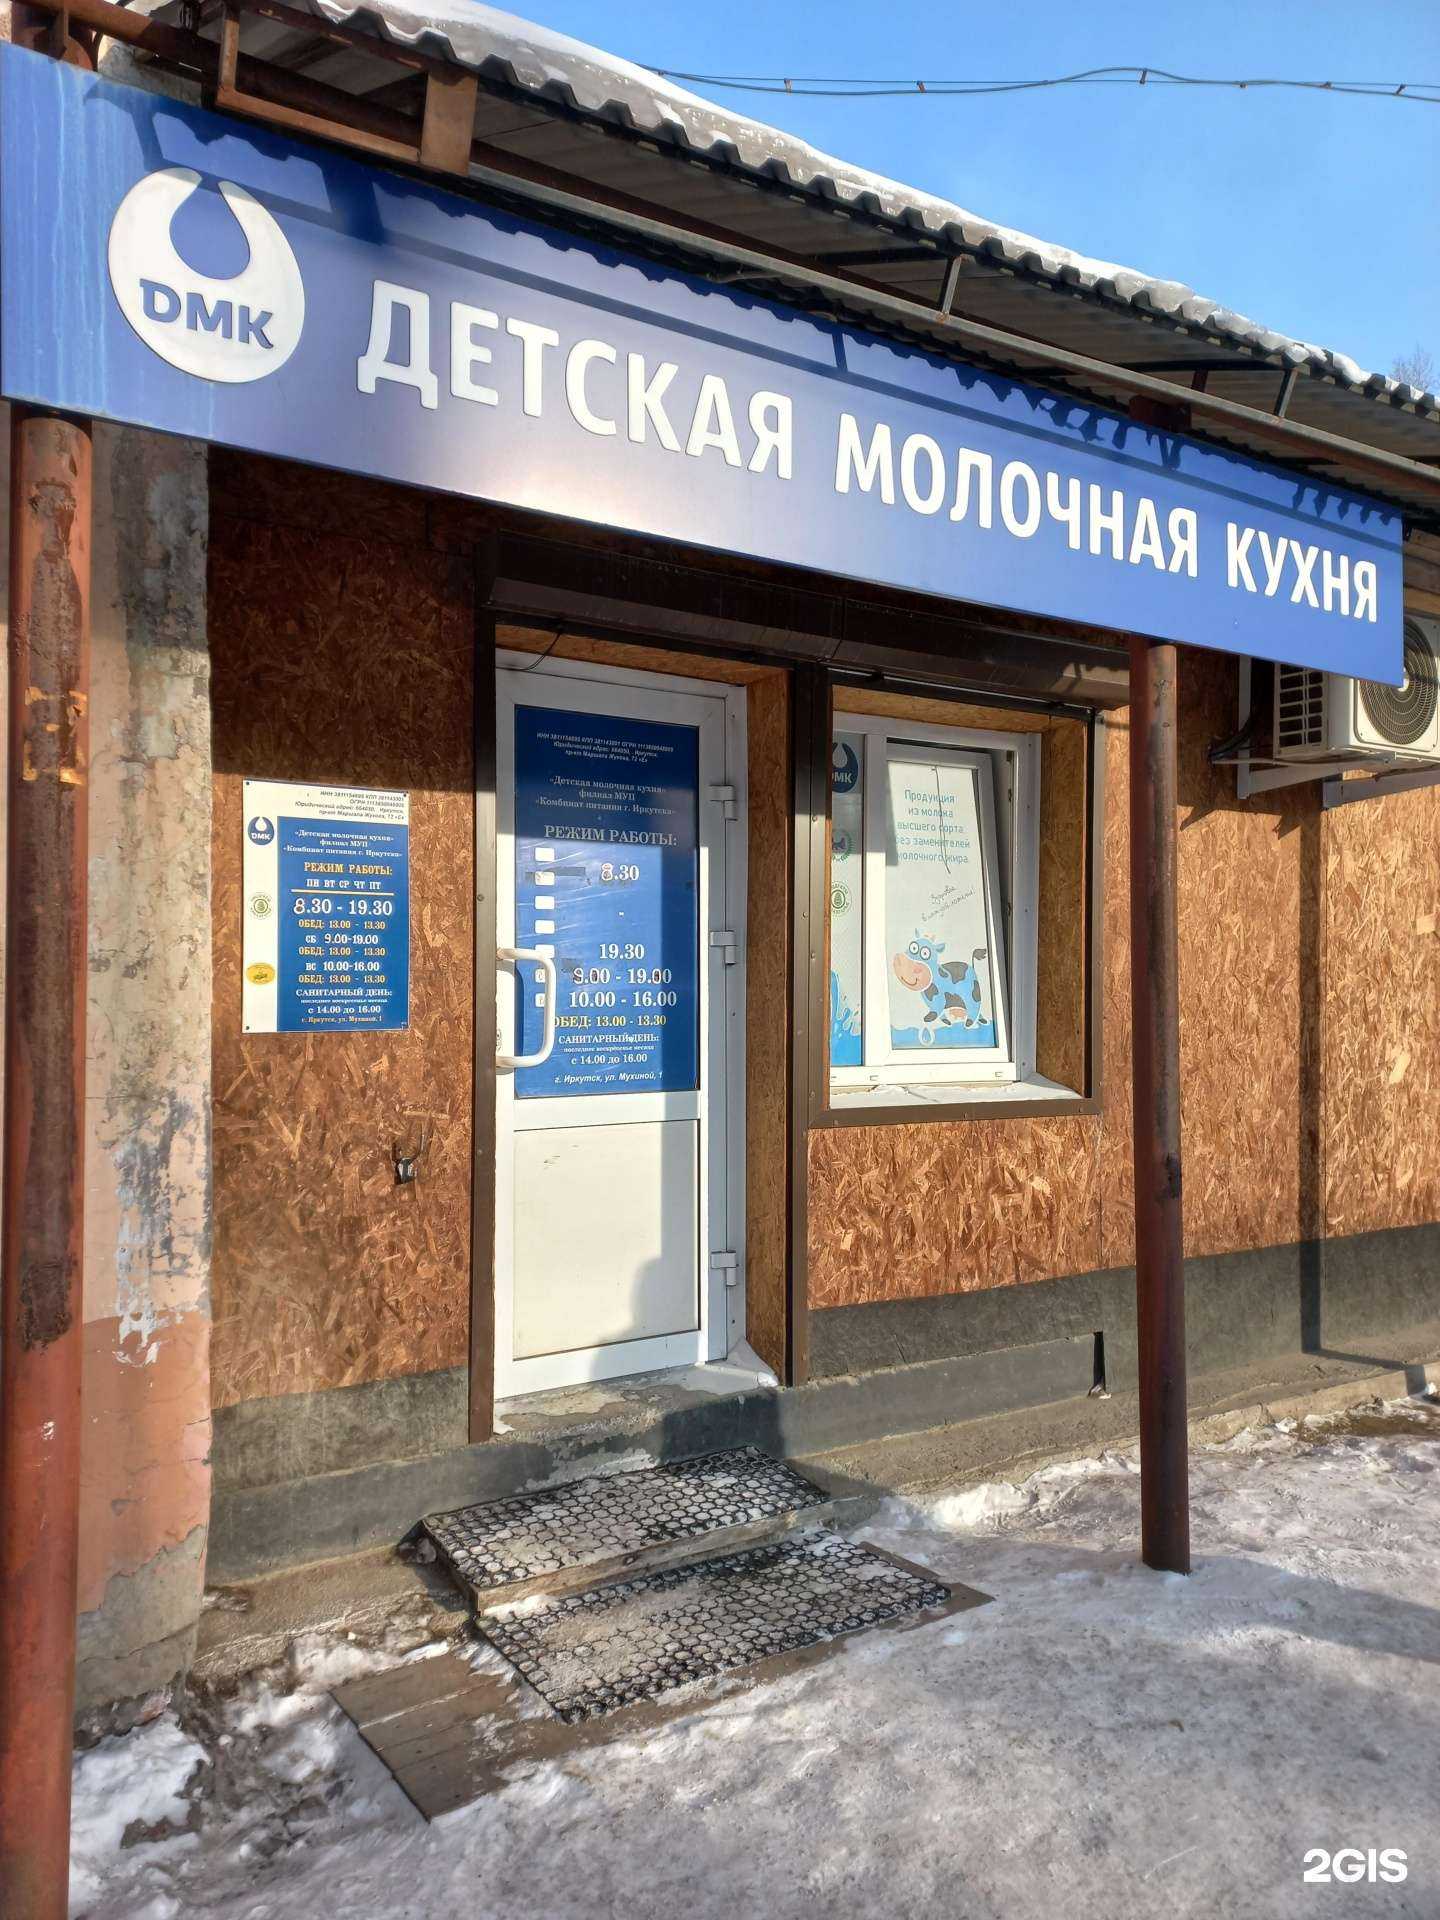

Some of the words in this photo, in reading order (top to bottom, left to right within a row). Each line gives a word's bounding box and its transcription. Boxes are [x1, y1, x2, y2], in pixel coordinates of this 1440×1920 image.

[357, 280, 793, 480] ДЕТСКАЯ
[834, 412, 1199, 578] МОЛОЧНАЯ
[1226, 521, 1378, 624] КУХНЯ
[832, 771, 853, 784] MK
[593, 781, 635, 791] молочная
[579, 789, 612, 801] филиал
[614, 791, 636, 800] МУП
[904, 789, 955, 804] Продукция
[908, 807, 919, 817] из
[921, 808, 953, 818] молока
[544, 825, 605, 842] РЕЖИМ
[608, 829, 678, 846] РАБОТЫ:
[319, 838, 349, 847] филиал
[350, 840, 368, 848] МУП
[304, 861, 345, 873] РЕЖИМ
[348, 863, 393, 875] РАБОТЫ:
[601, 862, 640, 881] 8.30
[306, 878, 320, 887] ПН
[324, 879, 336, 888] ВТ
[339, 880, 350, 889] СР
[353, 881, 365, 889] ЧТ
[369, 881, 382, 890] ПТ
[293, 897, 332, 915] 8.30
[348, 899, 393, 916] 19.30
[298, 919, 325, 930] ОБЕД:
[329, 920, 351, 929] 13.00
[364, 921, 386, 929] 13.30
[305, 935, 317, 944] СБ
[298, 946, 325, 957] ОБЕД:
[329, 947, 351, 956] 13.00
[364, 948, 386, 956] 13.30
[600, 943, 645, 960] 19.30
[305, 963, 317, 971] ВС
[323, 961, 380, 971] 10.00-16.00
[298, 974, 325, 985] ОБЕД:
[329, 975, 351, 984] 13.00
[364, 975, 386, 984] 13.30
[573, 967, 611, 985] 9.00
[627, 968, 672, 985] 19.00
[296, 987, 363, 997] САНИТАРНЫЙ
[365, 989, 393, 998] ДЕНЬ:
[569, 991, 616, 1008] 10.00
[633, 991, 677, 1007] 16.00
[317, 1005, 341, 1014] 14.00
[342, 1007, 355, 1015] до
[358, 1005, 381, 1014] 16.00
[596, 1016, 626, 1027] 13.00
[637, 1015, 667, 1026] 13.30
[558, 1033, 630, 1044] САНИТАРНЫЙ
[580, 1055, 606, 1065] 14.00
[607, 1056, 620, 1065] до
[623, 1054, 648, 1064] 16.00
[563, 1074, 603, 1085] Иркутск,
[604, 1074, 616, 1084] ул.
[618, 1071, 656, 1081] Мухиной,
